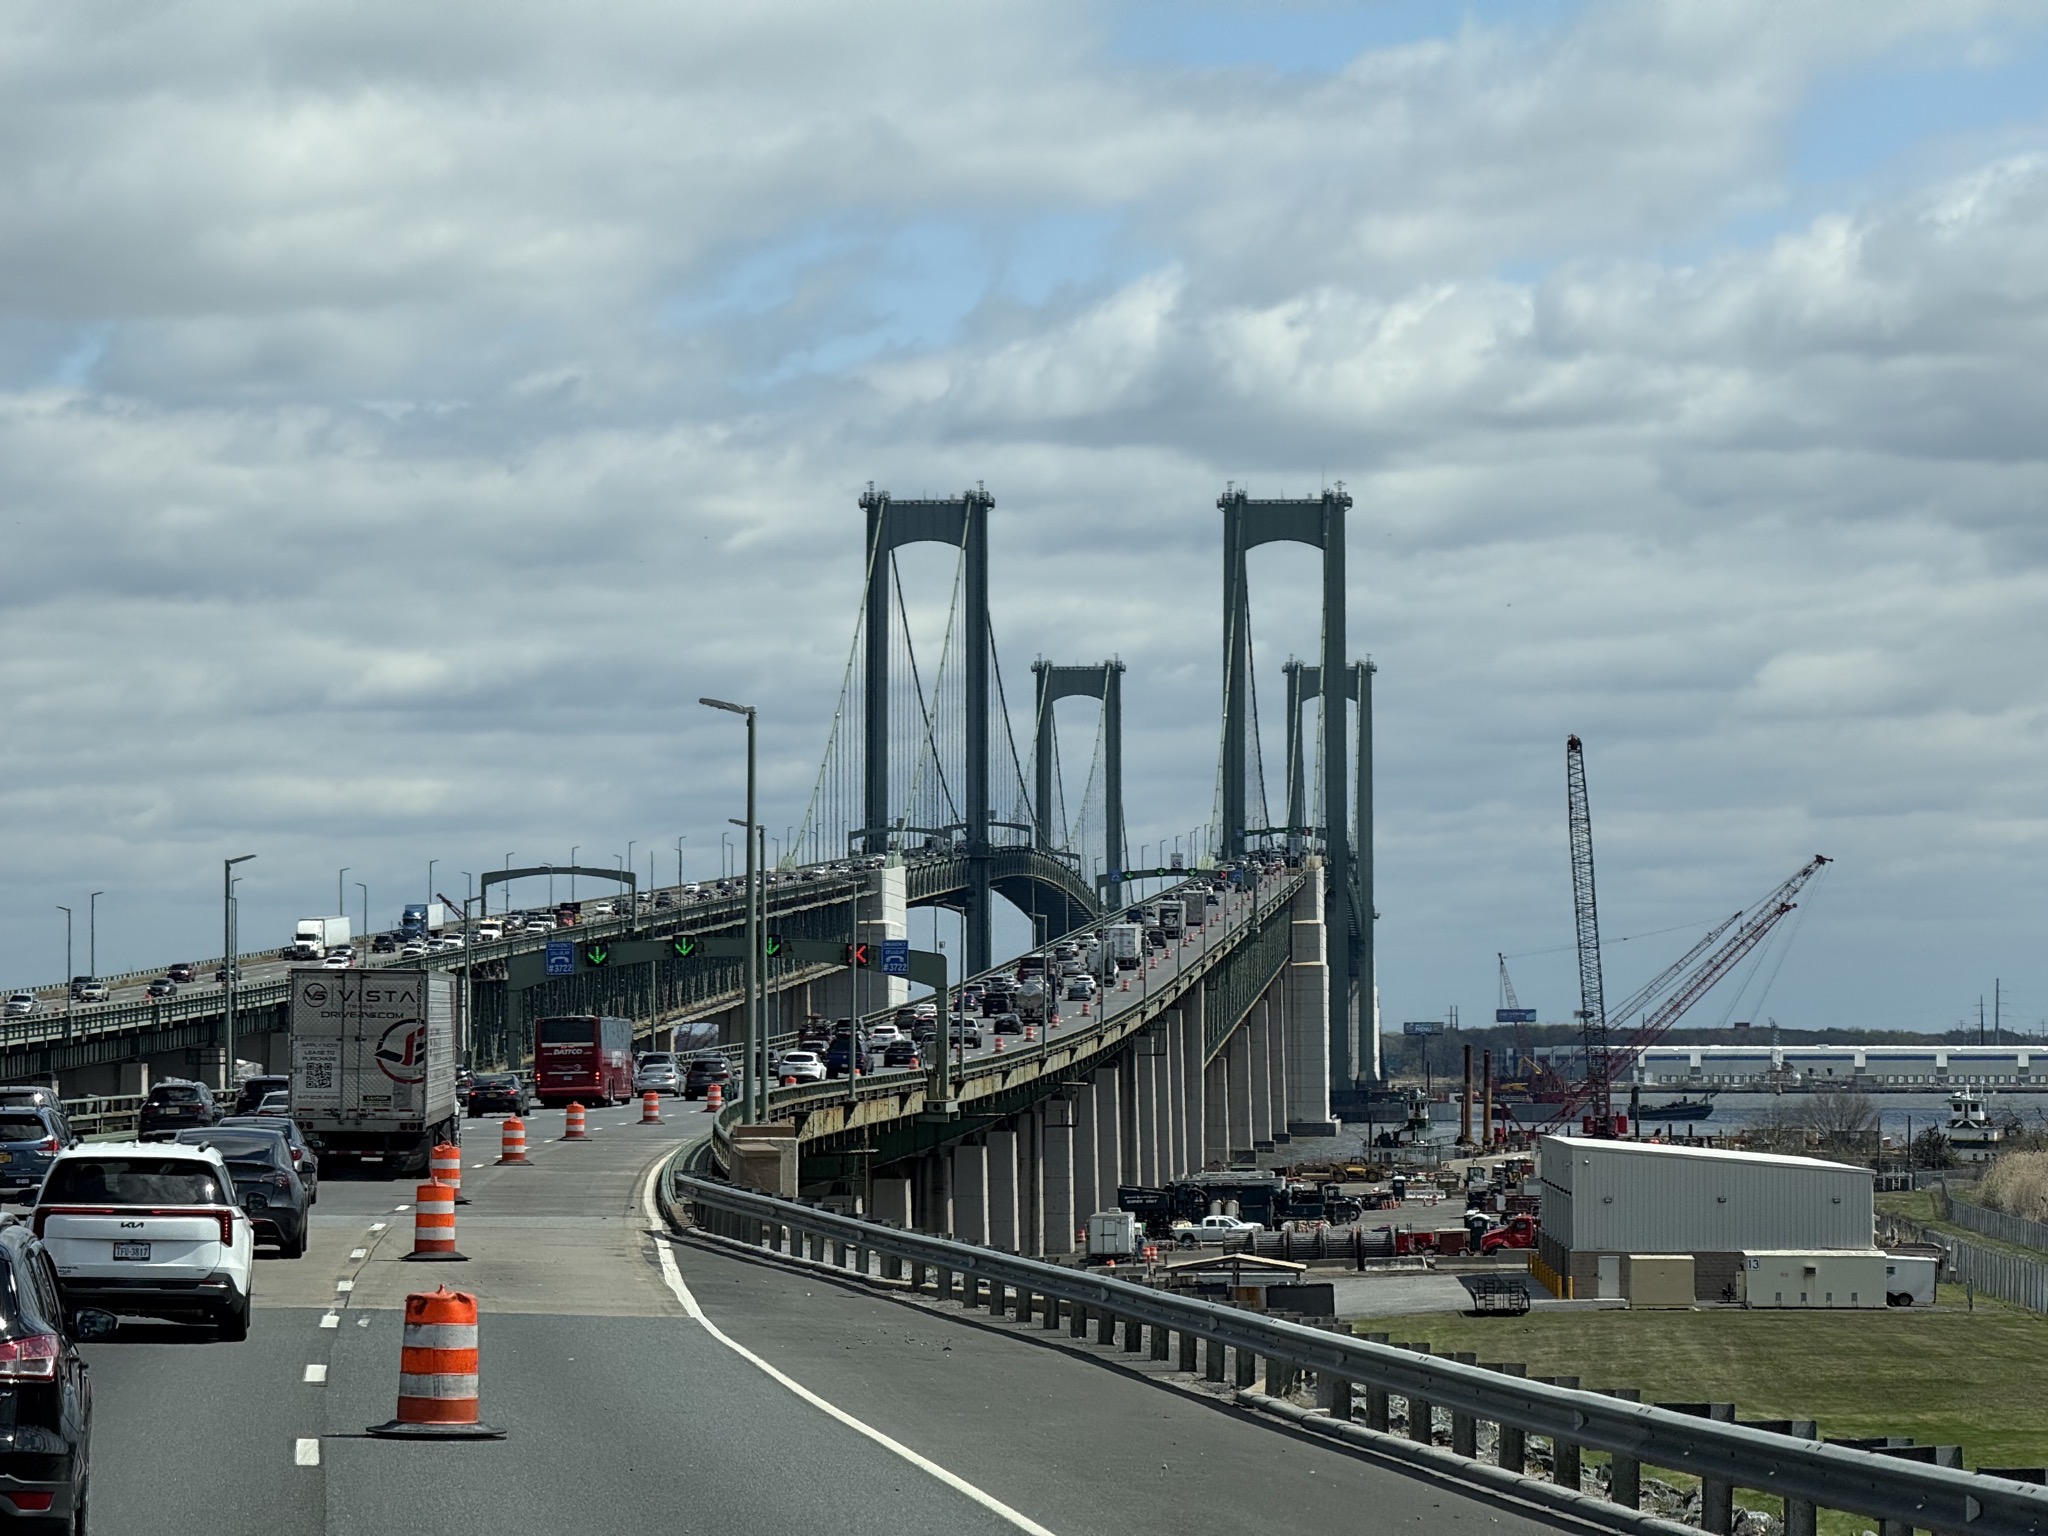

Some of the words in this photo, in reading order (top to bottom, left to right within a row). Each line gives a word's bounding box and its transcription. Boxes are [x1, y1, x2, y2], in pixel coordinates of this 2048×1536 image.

[549, 964, 572, 973] #3722
[884, 963, 907, 972] #3722
[338, 990, 415, 1003] VISTA
[1748, 1259, 1759, 1269] 13
